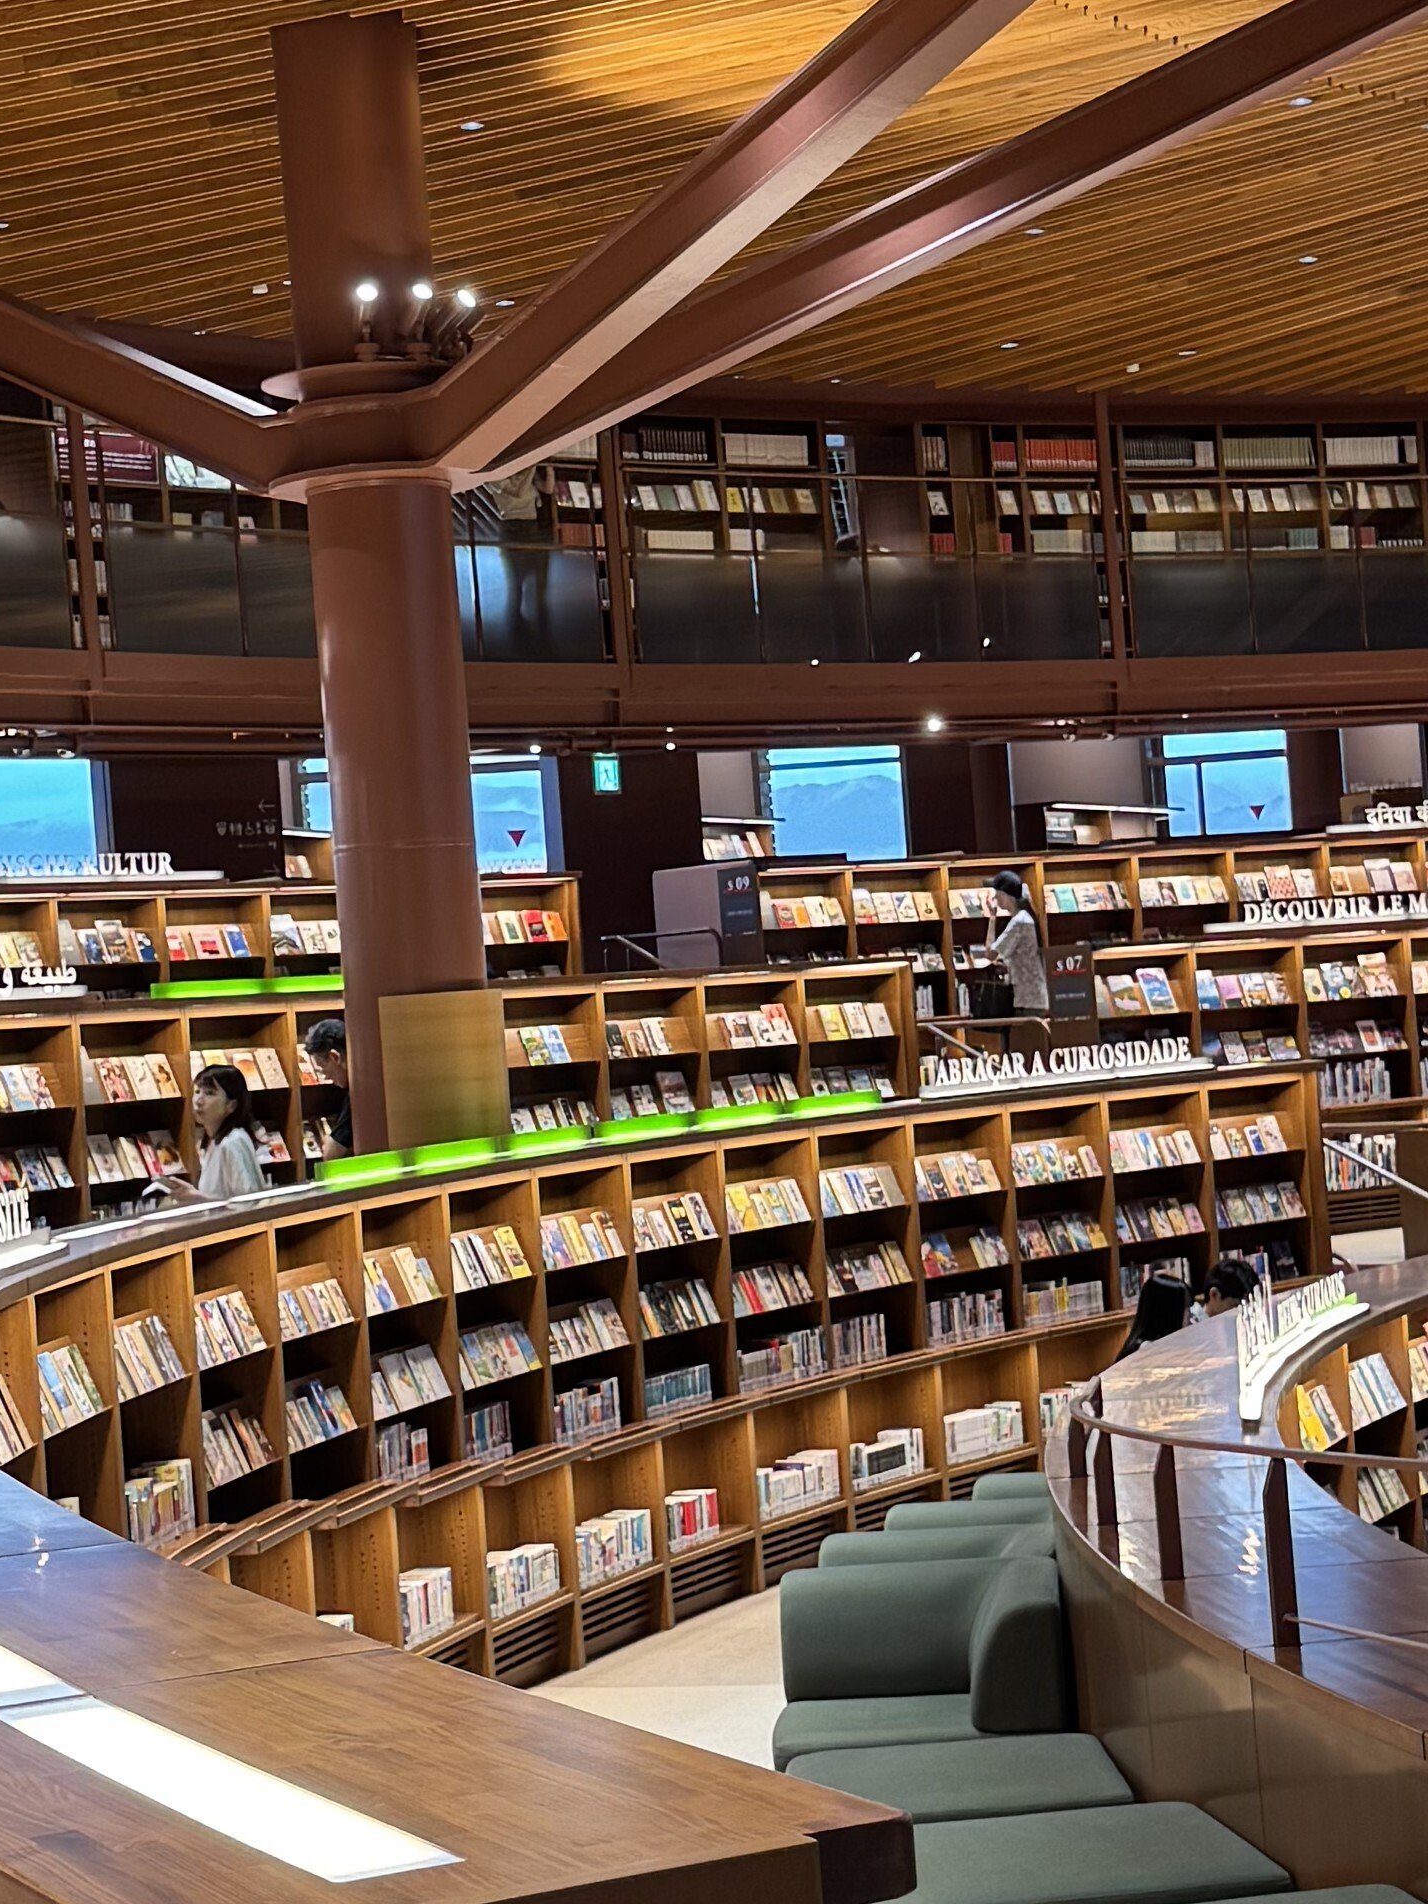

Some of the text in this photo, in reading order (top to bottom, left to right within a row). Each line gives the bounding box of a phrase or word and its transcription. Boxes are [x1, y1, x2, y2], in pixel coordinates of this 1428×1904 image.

[1365, 802, 1411, 831] दुनिया
[80, 852, 174, 877] KULTUR
[735, 876, 750, 890] 09
[1243, 896, 1372, 924] DÉCOUVRIR
[1378, 892, 1404, 915] LE
[1066, 955, 1083, 971] 07
[936, 1036, 1192, 1087] ABRAÇAR A CURIOSIDADE
